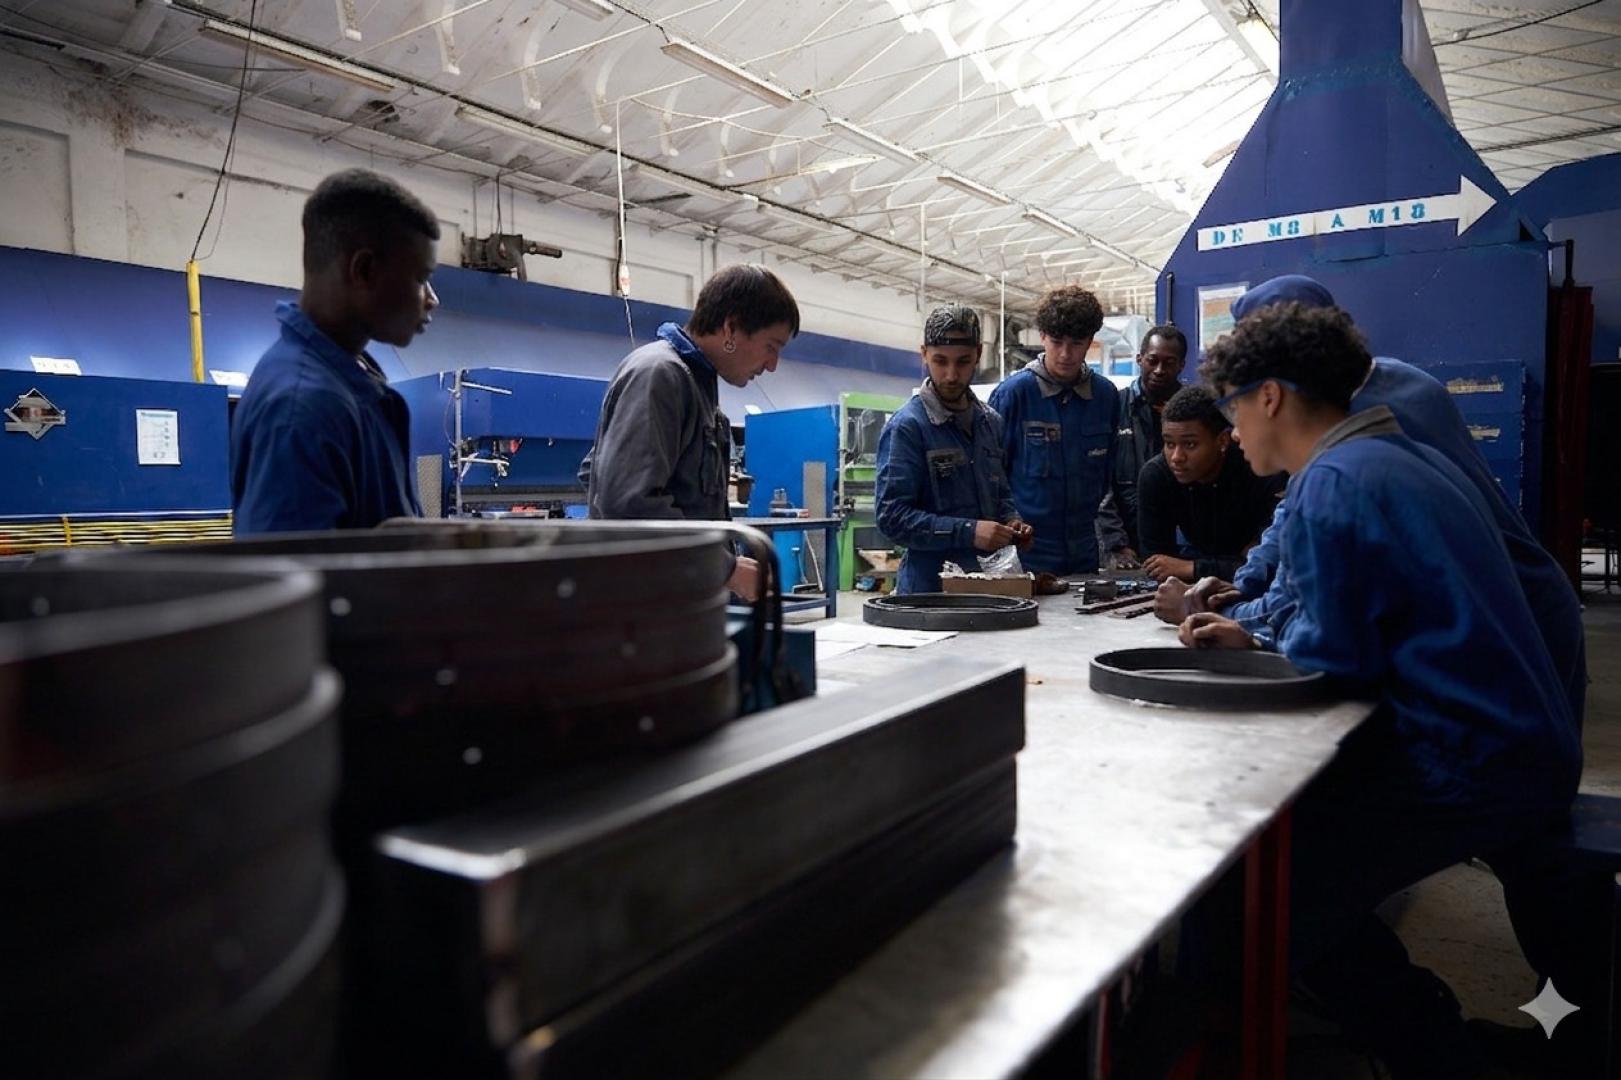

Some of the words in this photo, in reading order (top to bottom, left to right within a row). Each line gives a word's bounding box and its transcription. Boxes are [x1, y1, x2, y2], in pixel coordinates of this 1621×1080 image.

[1212, 228, 1244, 245] DE
[1268, 220, 1300, 237] M8
[1331, 213, 1344, 228] A
[1368, 203, 1425, 224] M18
